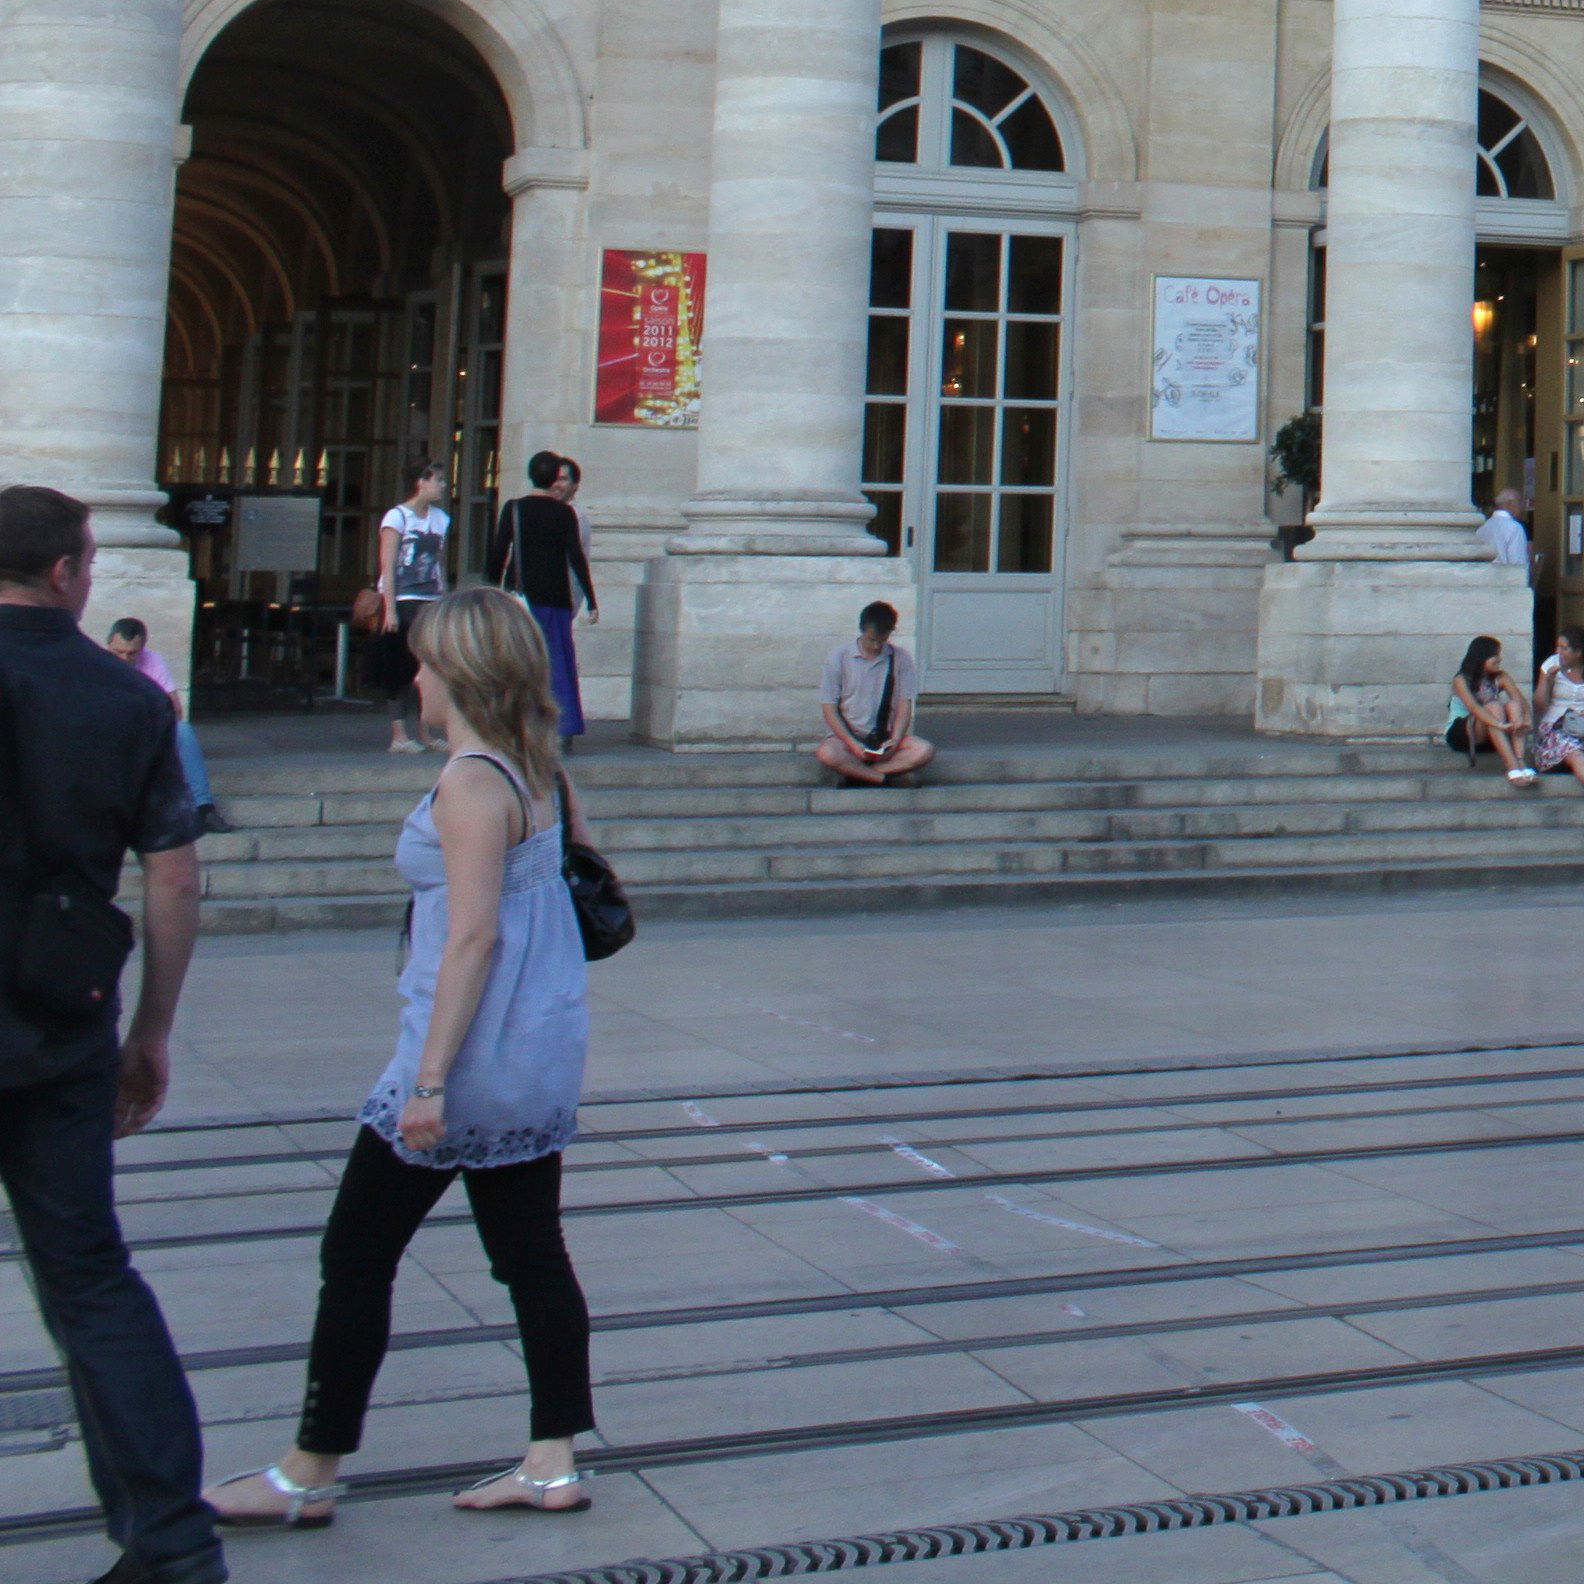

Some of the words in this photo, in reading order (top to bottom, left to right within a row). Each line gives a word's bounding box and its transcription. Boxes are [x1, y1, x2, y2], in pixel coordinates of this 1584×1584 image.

[1206, 285, 1250, 309] Opéra
[643, 325, 673, 336] 2011
[642, 336, 673, 348] 2012
